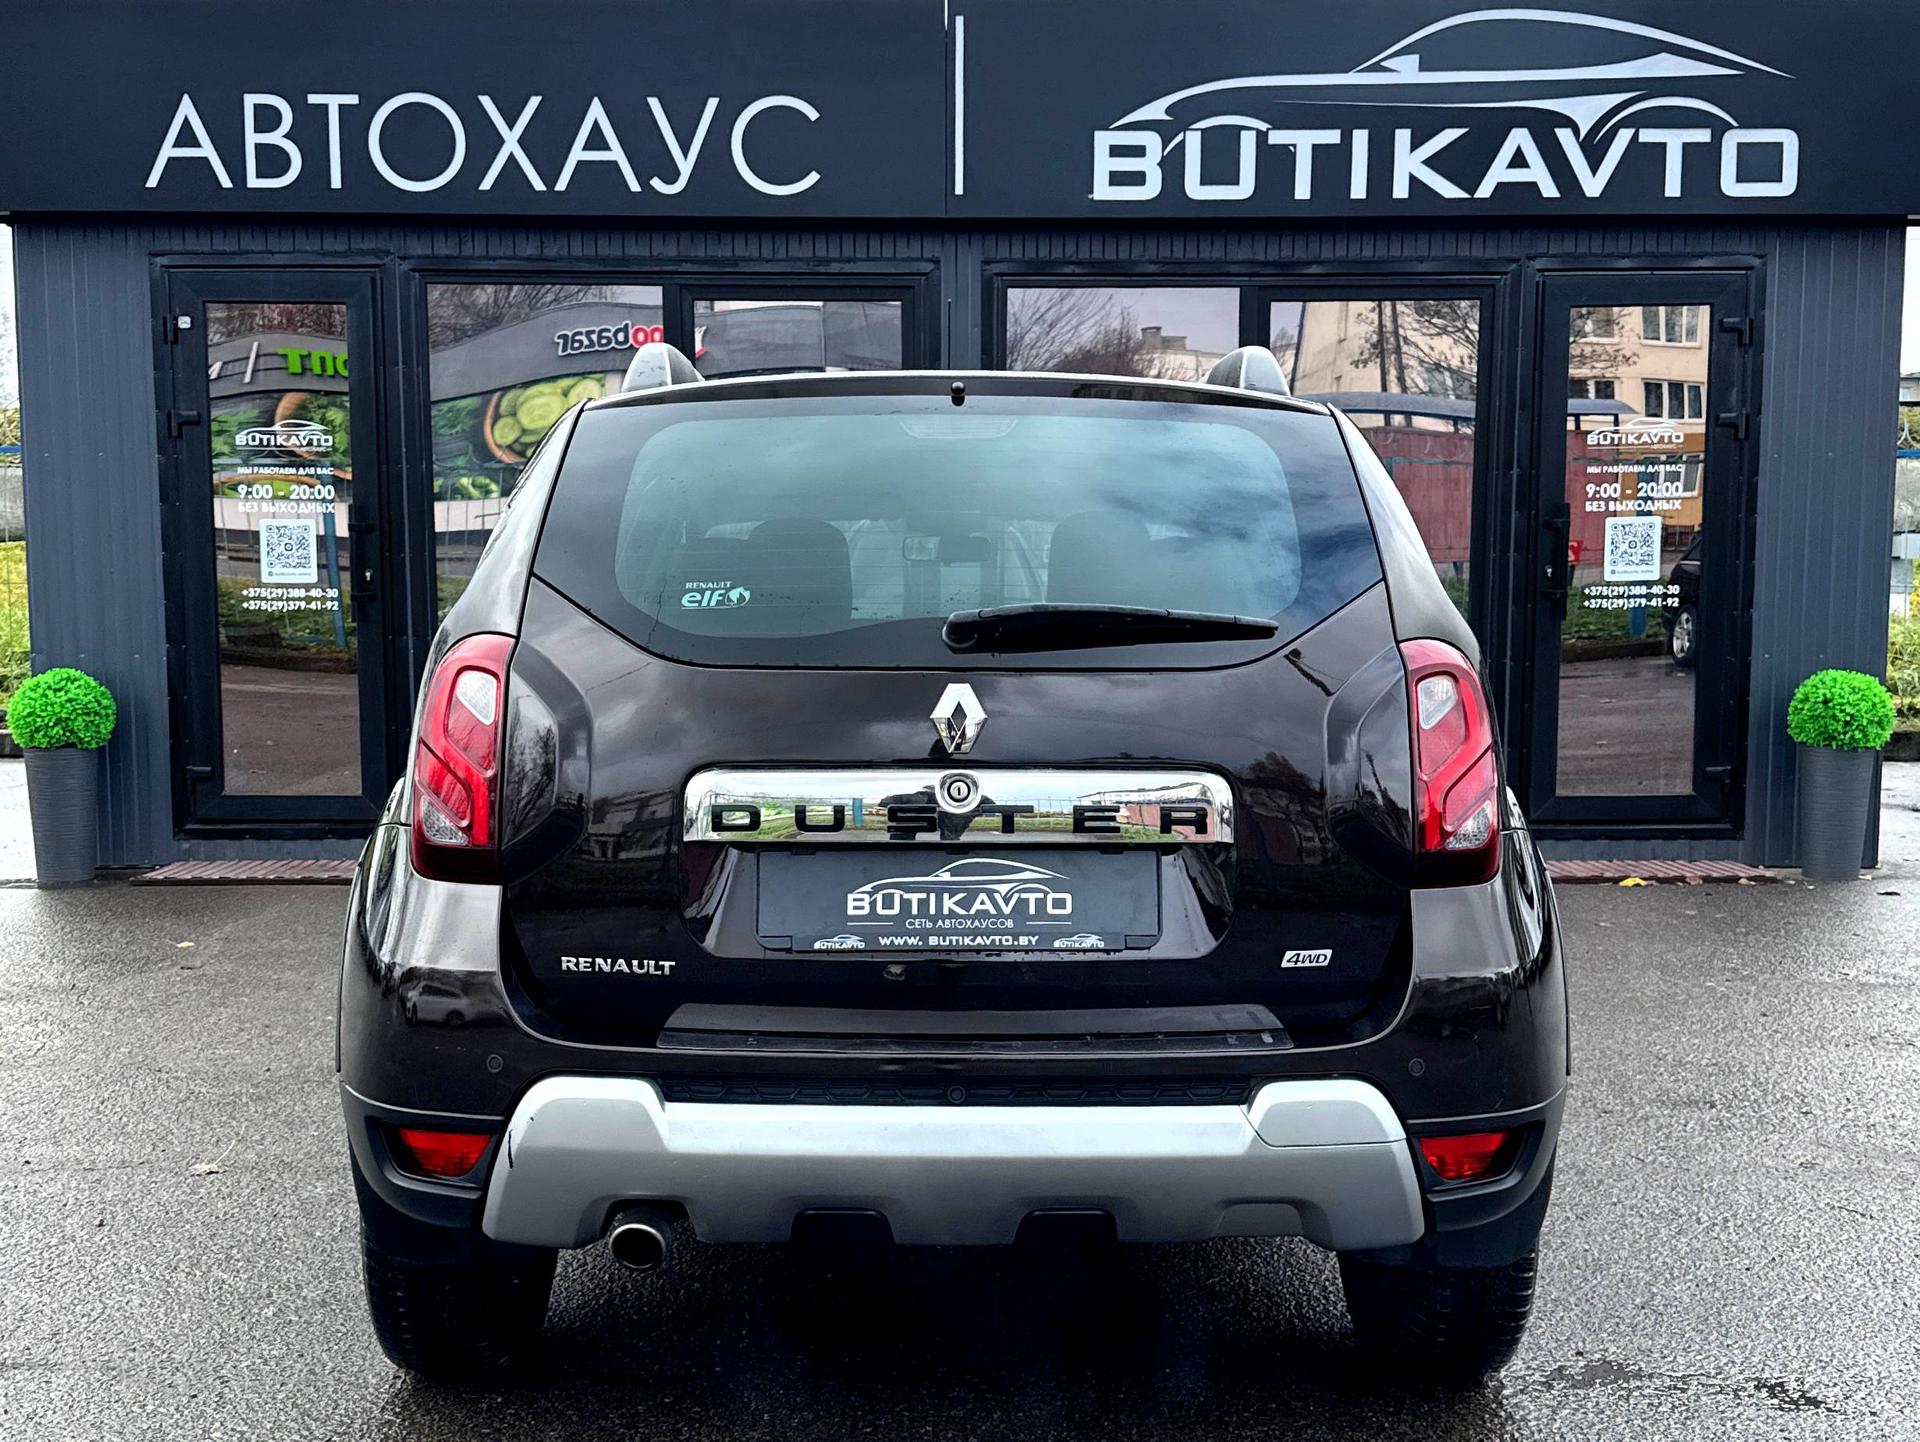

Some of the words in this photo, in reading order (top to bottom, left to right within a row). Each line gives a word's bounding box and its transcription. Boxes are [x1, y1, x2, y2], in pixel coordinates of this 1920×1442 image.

[145, 92, 821, 196] АВТОХАУС
[1092, 127, 1799, 200] BUTIKAVTO
[235, 434, 333, 446] BUTIKAVTO
[1586, 431, 1684, 445] BUTIKAVTO
[237, 467, 252, 475] МЫ
[254, 467, 297, 475] РАБОТАЕМ
[298, 467, 315, 475] ДЛЯ
[317, 467, 334, 475] ВАС
[1586, 466, 1601, 474] МЫ
[1602, 465, 1645, 473] РАБОТАЕМ
[1647, 464, 1664, 473] ДЛЯ
[1665, 464, 1683, 472] ВАС
[237, 484, 273, 500] 9:00
[289, 484, 335, 500] 20:00
[1585, 483, 1620, 498] 9:00
[1637, 482, 1682, 497] 20:00
[238, 502, 259, 513] БЕЗ
[262, 502, 335, 514] ВЫХОДНЫХ
[1585, 501, 1606, 512] БЕЗ
[1608, 500, 1682, 512] ВЫХОДНЫХ
[685, 581, 732, 589] RENAULT
[681, 589, 726, 607] elf
[1583, 598, 1679, 609] +375(29)379-41-92
[242, 601, 339, 611] +375(29)379-41-92
[711, 804, 1209, 835] DUSTER
[847, 892, 1072, 916] BUTIKAVTO
[905, 918, 932, 929] СЕТЬ
[935, 918, 1014, 929] АВТОХАУСОВ
[813, 940, 866, 949] BUTIKAVTO
[879, 936, 923, 946] WWW.
[928, 935, 1039, 946] BUTIKAVTO.BY
[1053, 939, 1105, 948] BUTIKAVTO
[1286, 952, 1328, 965] 4WD
[560, 956, 676, 976] RENAULT
